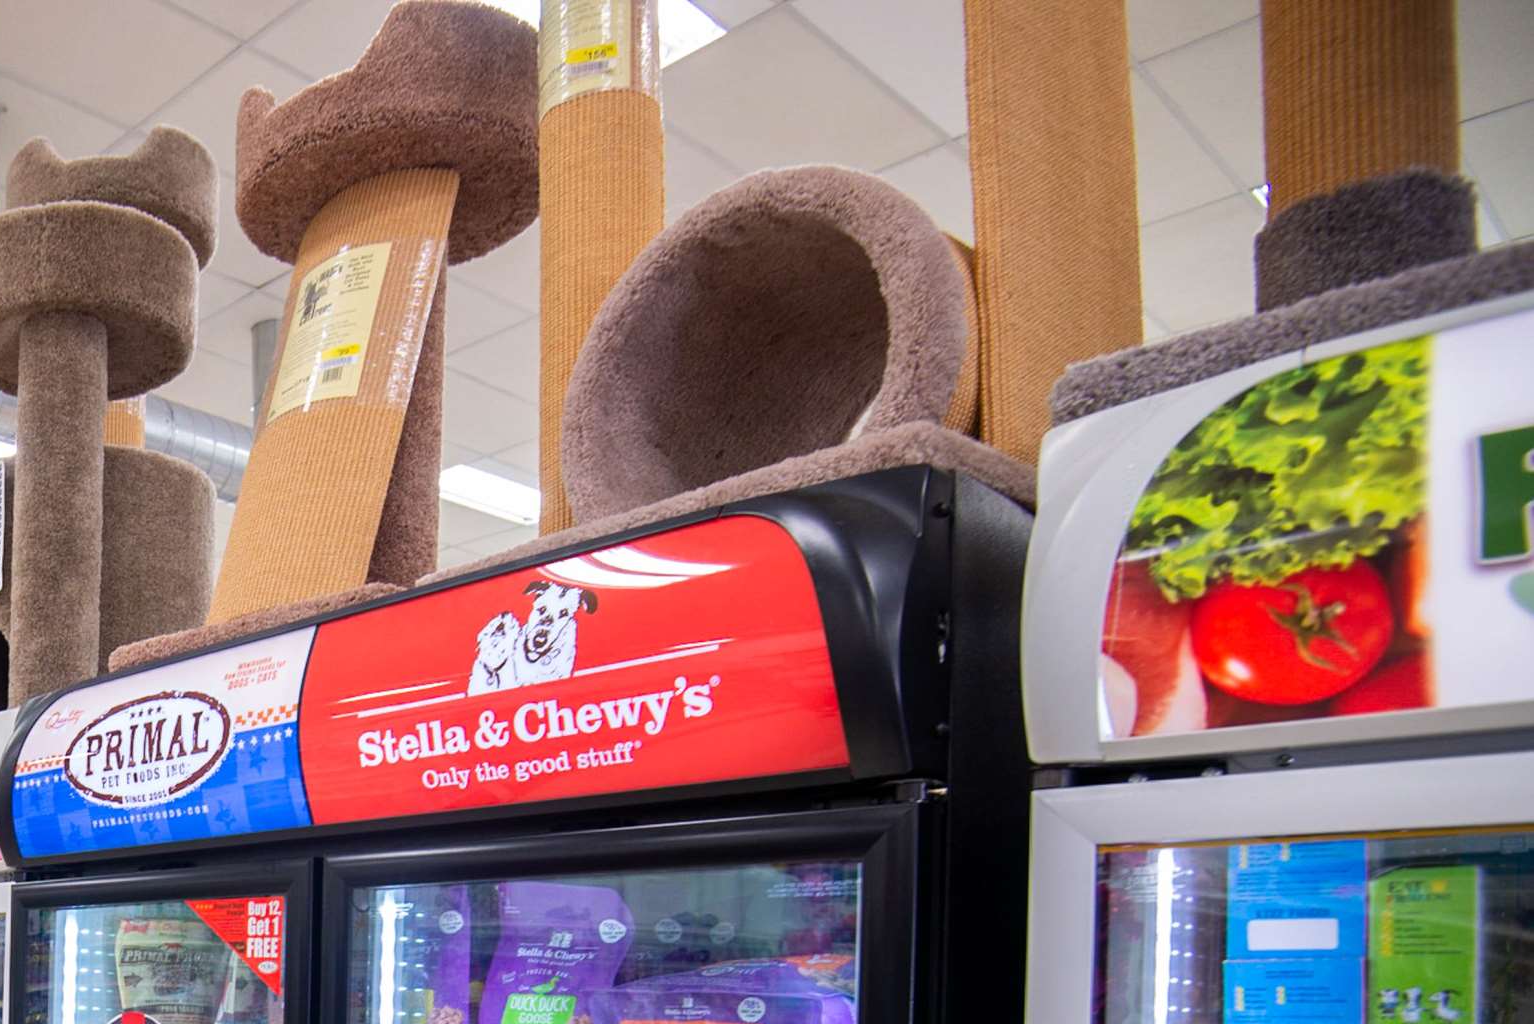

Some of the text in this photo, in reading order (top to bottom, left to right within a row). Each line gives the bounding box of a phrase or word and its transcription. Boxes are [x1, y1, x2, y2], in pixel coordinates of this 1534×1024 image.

[358, 676, 714, 768] Stella & Chewy's
[85, 711, 210, 776] PRIMAL
[422, 743, 634, 792] Only the good stuff
[101, 775, 121, 789] PET
[126, 769, 160, 787] FOODS
[248, 900, 266, 917] Buy
[247, 916, 279, 936] Get 1
[247, 937, 278, 958] FREE
[517, 947, 543, 958] Stella
[509, 995, 569, 1013] DUCK DUCK
[518, 1011, 555, 1024] GOOSE
